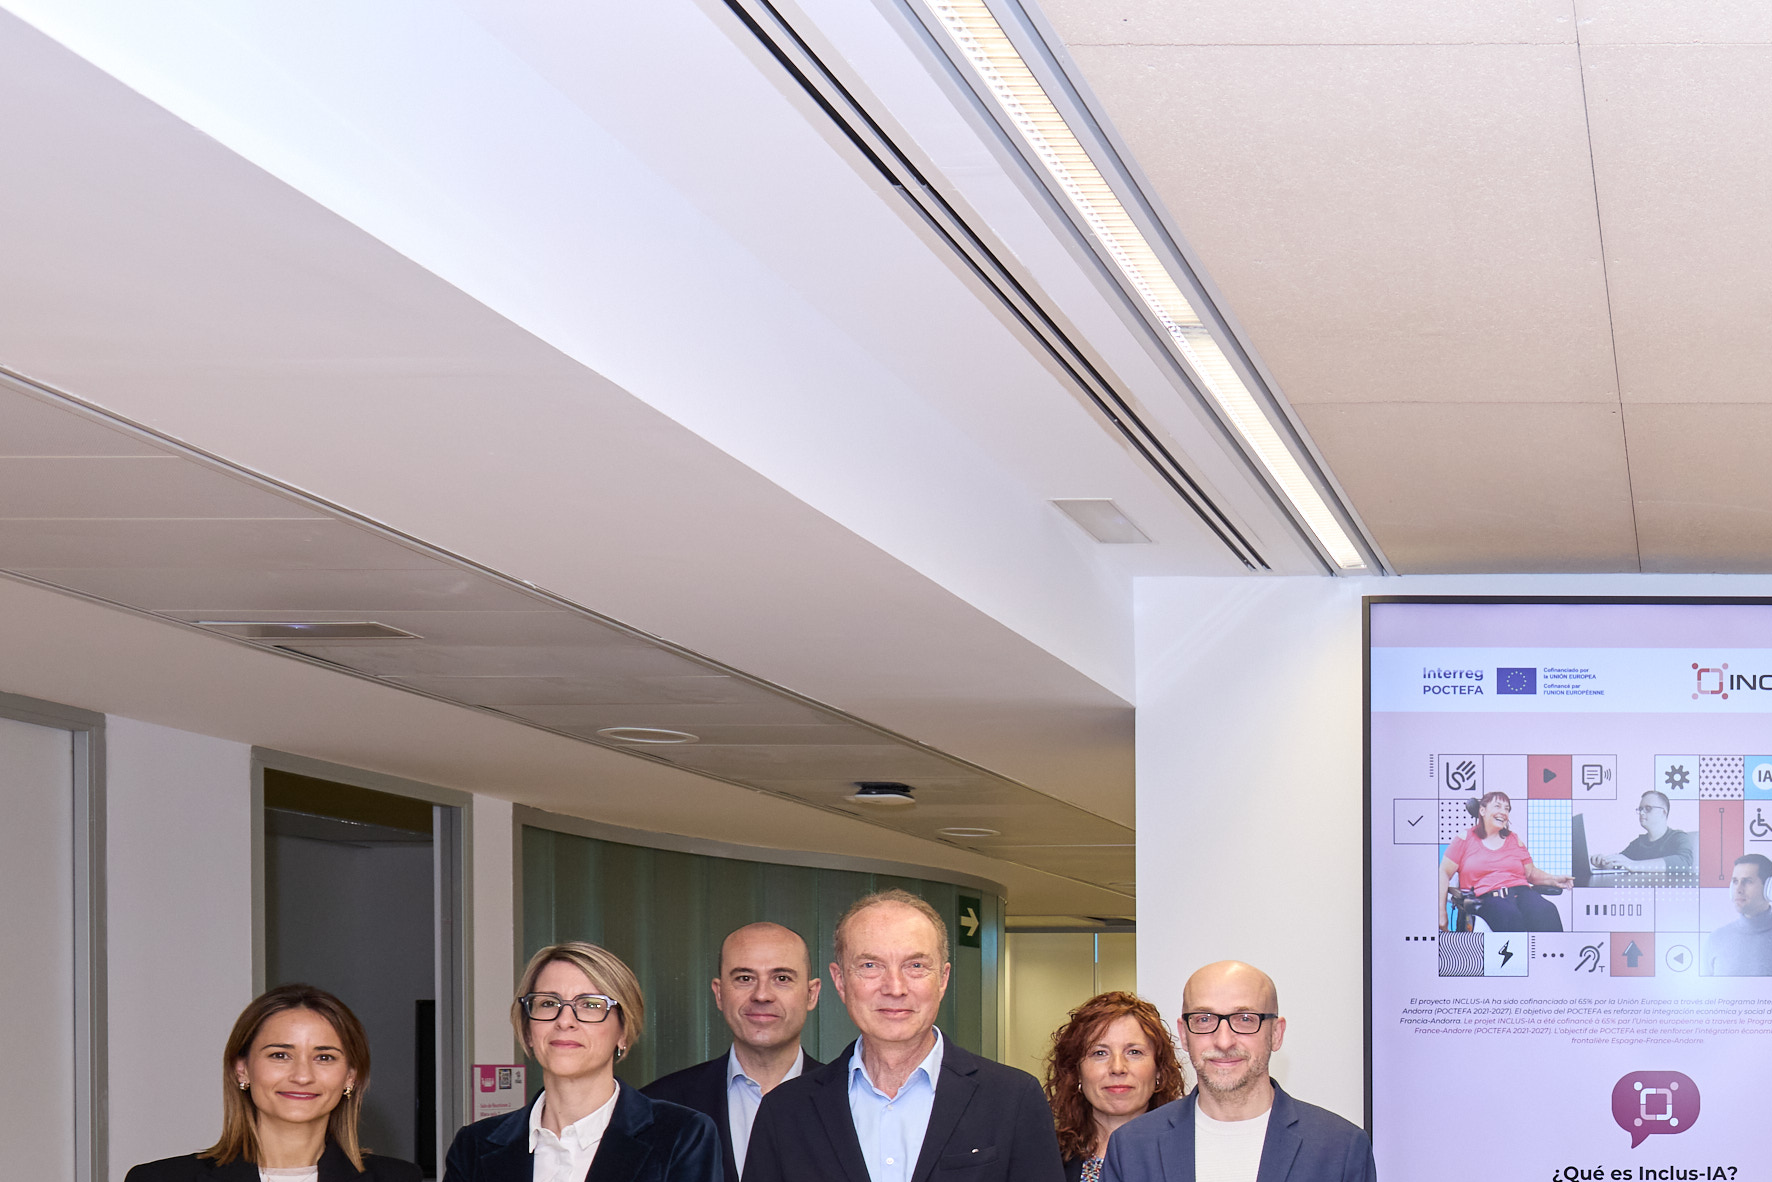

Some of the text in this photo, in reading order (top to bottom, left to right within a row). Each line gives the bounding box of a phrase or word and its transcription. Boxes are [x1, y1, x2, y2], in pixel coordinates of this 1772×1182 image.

[1423, 668, 1483, 681] Interreg
[1423, 685, 1484, 695] POCTEFA
[1758, 770, 1772, 782] IA
[1641, 998, 1672, 1006] Europea
[1717, 998, 1756, 1006] Programa
[1652, 1008, 1694, 1016] integración
[1610, 1169, 1633, 1181] es
[1639, 1165, 1738, 1181] Inclus-IA?
